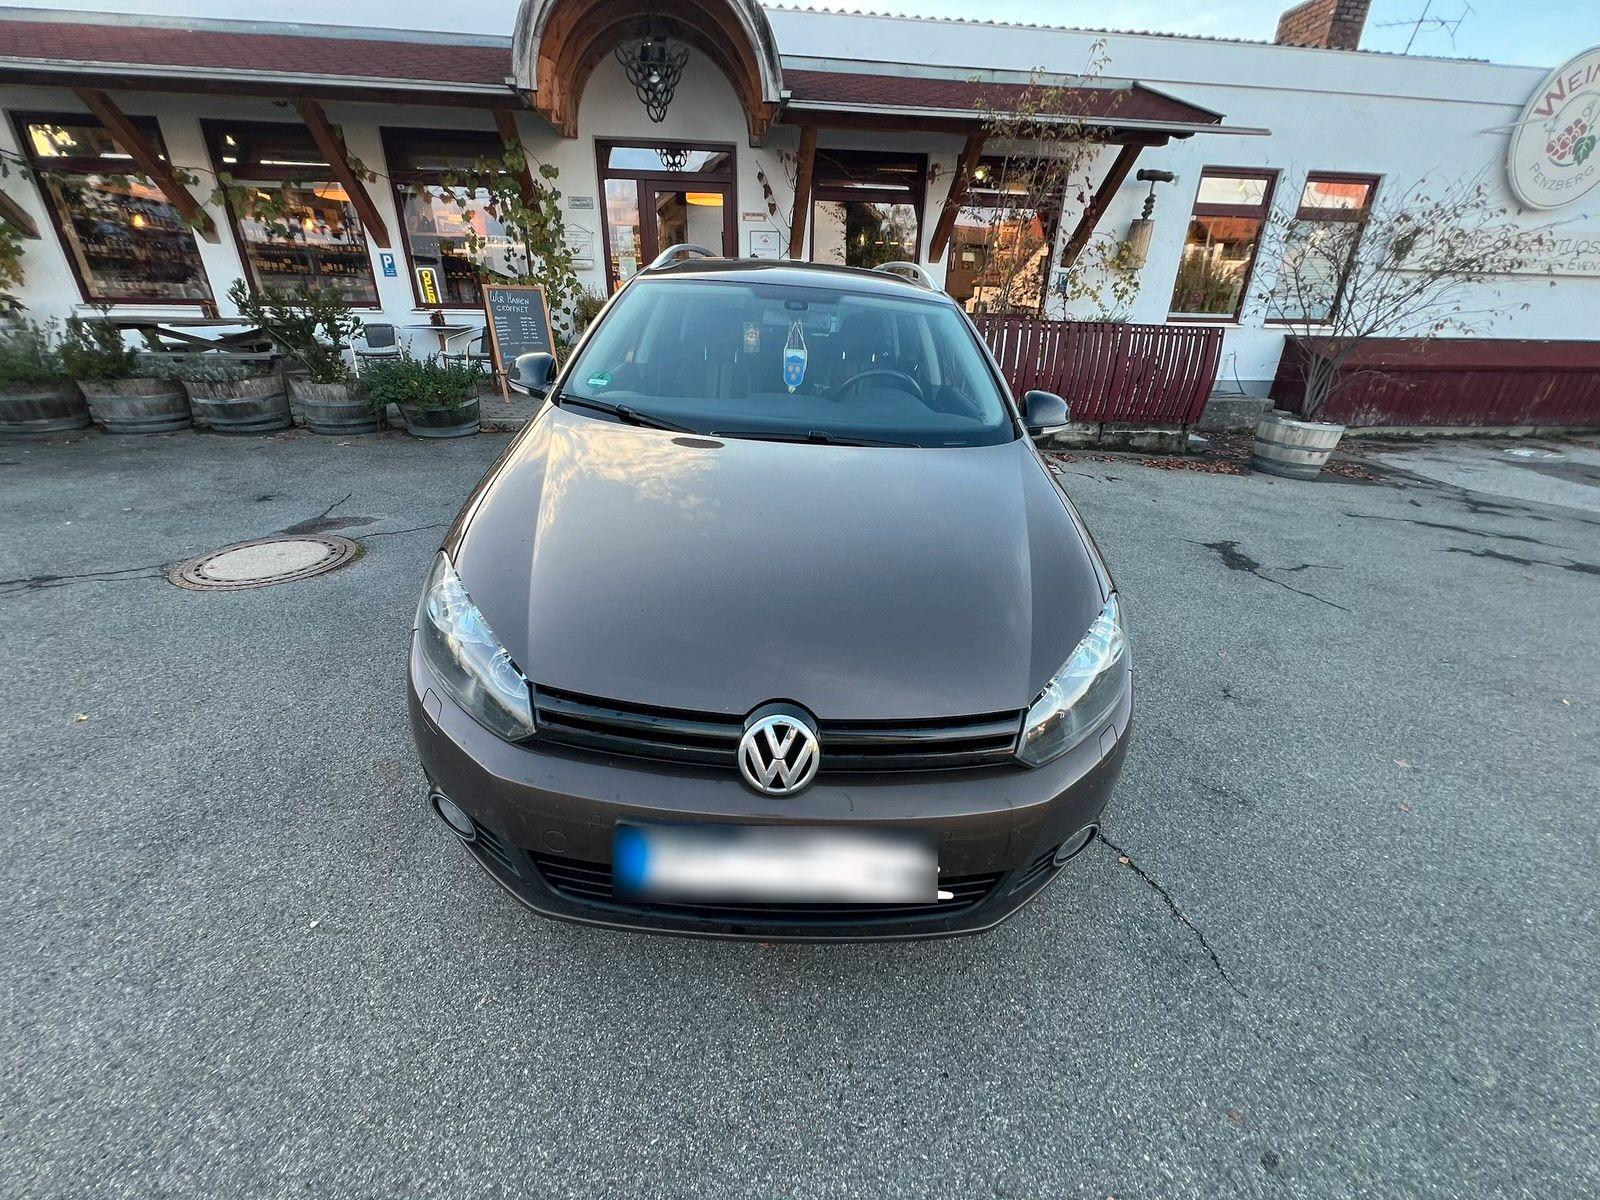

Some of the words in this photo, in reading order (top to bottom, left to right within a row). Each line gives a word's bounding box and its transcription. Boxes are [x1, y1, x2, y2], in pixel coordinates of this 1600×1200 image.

[1528, 161, 1594, 191] PENZBERG
[383, 255, 393, 268] P
[422, 270, 437, 304] OPEN
